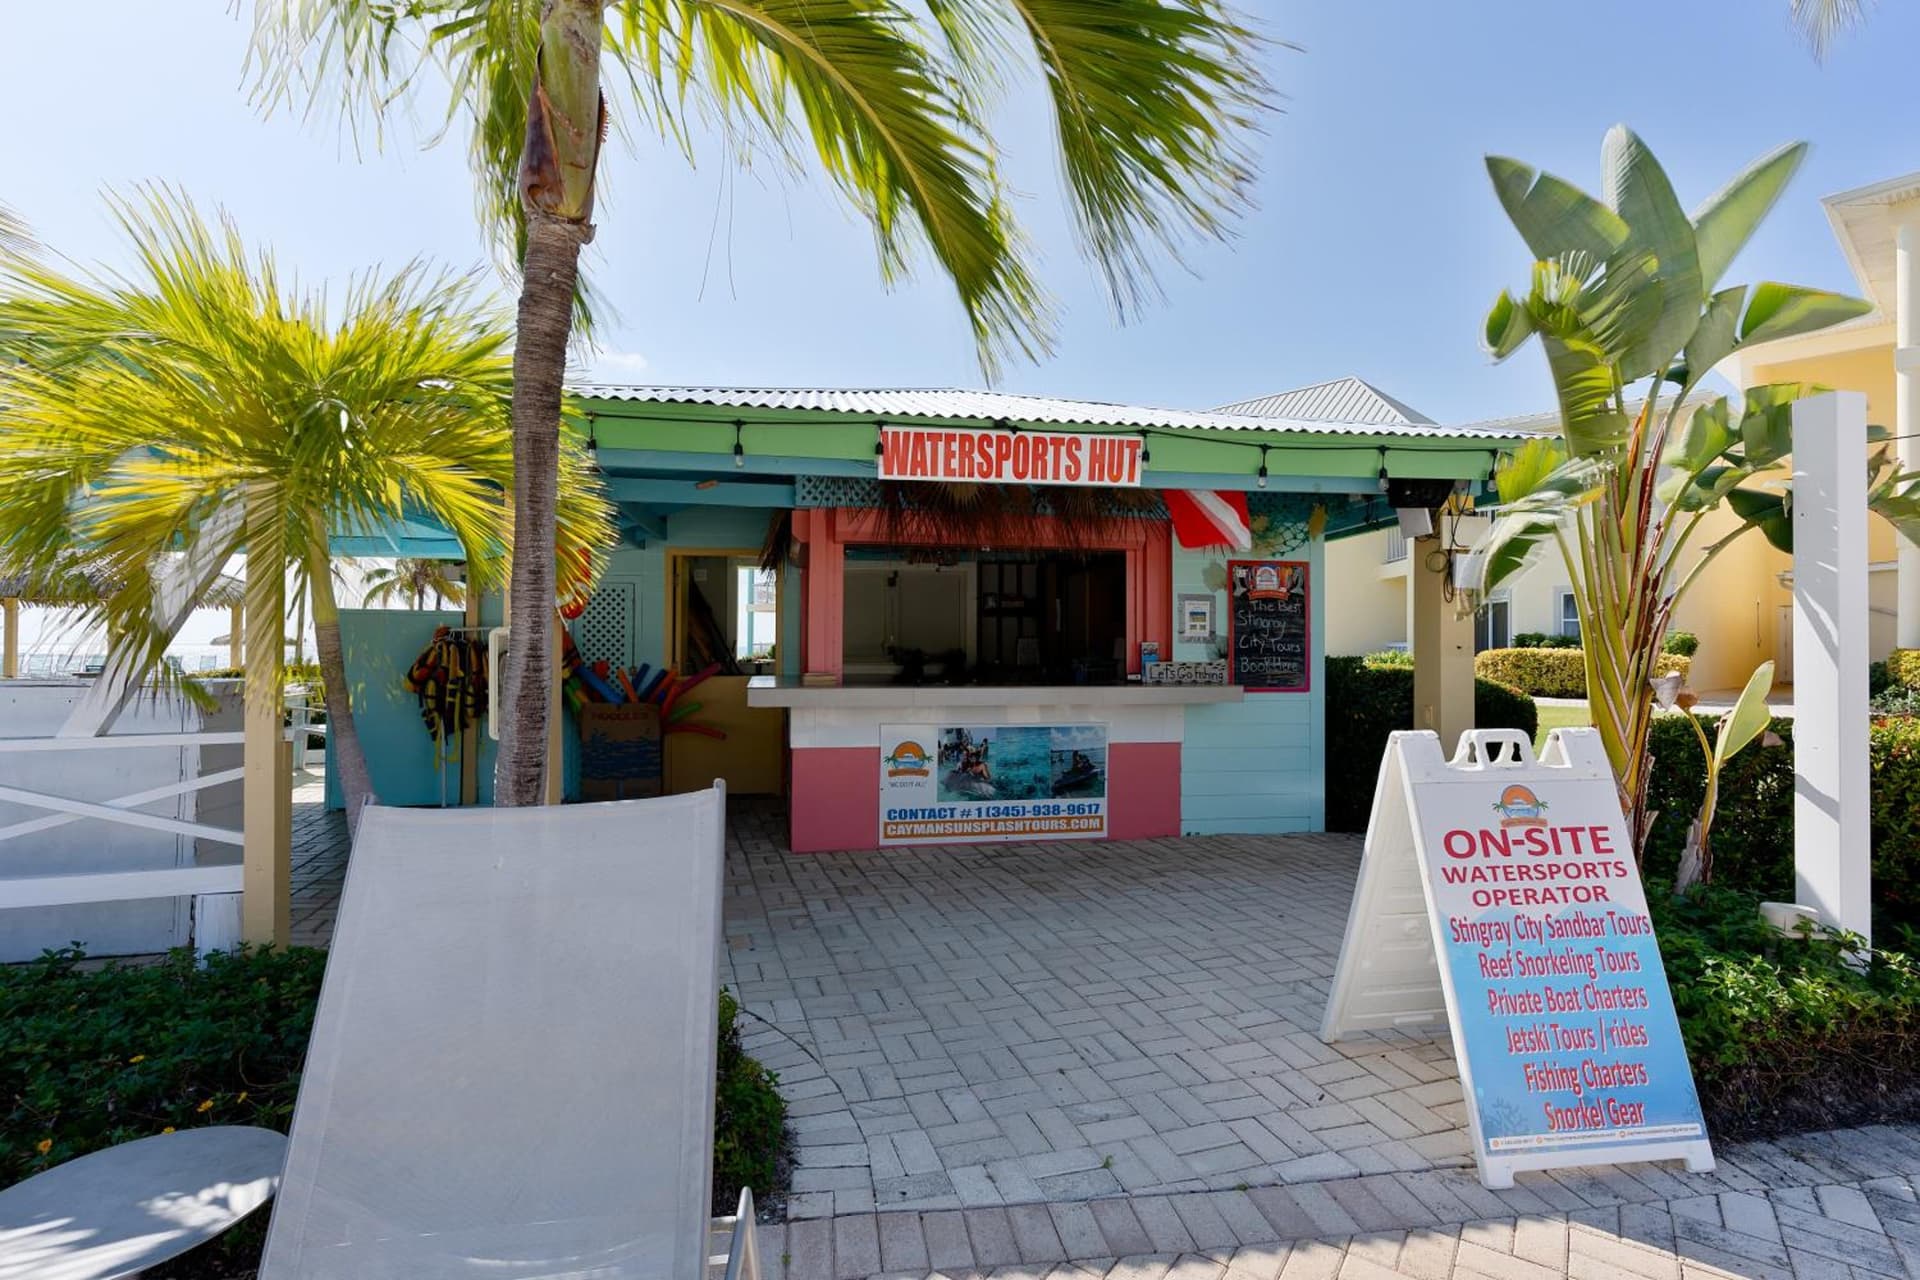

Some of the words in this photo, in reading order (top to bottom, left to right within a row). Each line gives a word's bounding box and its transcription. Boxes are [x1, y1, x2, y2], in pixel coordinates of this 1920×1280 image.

[881, 430, 1082, 482] WATERSPORTS
[1088, 438, 1142, 483] HUT
[1249, 601, 1275, 612] The
[1237, 610, 1287, 640] Stingray
[1239, 635, 1265, 653] City
[1271, 639, 1301, 652] Tours
[1177, 666, 1193, 680] Go
[1241, 657, 1270, 673] Book
[887, 807, 957, 821] CONTACT
[960, 808, 973, 818] #
[887, 818, 1100, 835] CAYMANSUNSPLASHTOURS.COM
[1443, 826, 1614, 859] ON-SITE
[1441, 861, 1628, 884] WATERSPORTS
[1472, 885, 1610, 907] OPERATOR
[1450, 917, 1512, 948] Stingray
[1513, 914, 1544, 946] City
[1548, 912, 1606, 939] Sandbar
[1607, 911, 1651, 935] Tours
[1478, 951, 1514, 979] Reef
[1515, 948, 1598, 980] Snorkeling
[1596, 947, 1640, 973] Tours
[1487, 988, 1543, 1015] Private
[1544, 986, 1583, 1012] Boat
[1583, 983, 1649, 1010] Charters
[1507, 1023, 1549, 1054] Jetski
[1552, 1023, 1596, 1050] Tours
[1610, 1018, 1648, 1047] rides
[1523, 1062, 1583, 1096] Fishing
[1583, 1059, 1649, 1087] Charters
[1544, 1098, 1605, 1130] Snorkel
[1607, 1097, 1645, 1126] Gear
